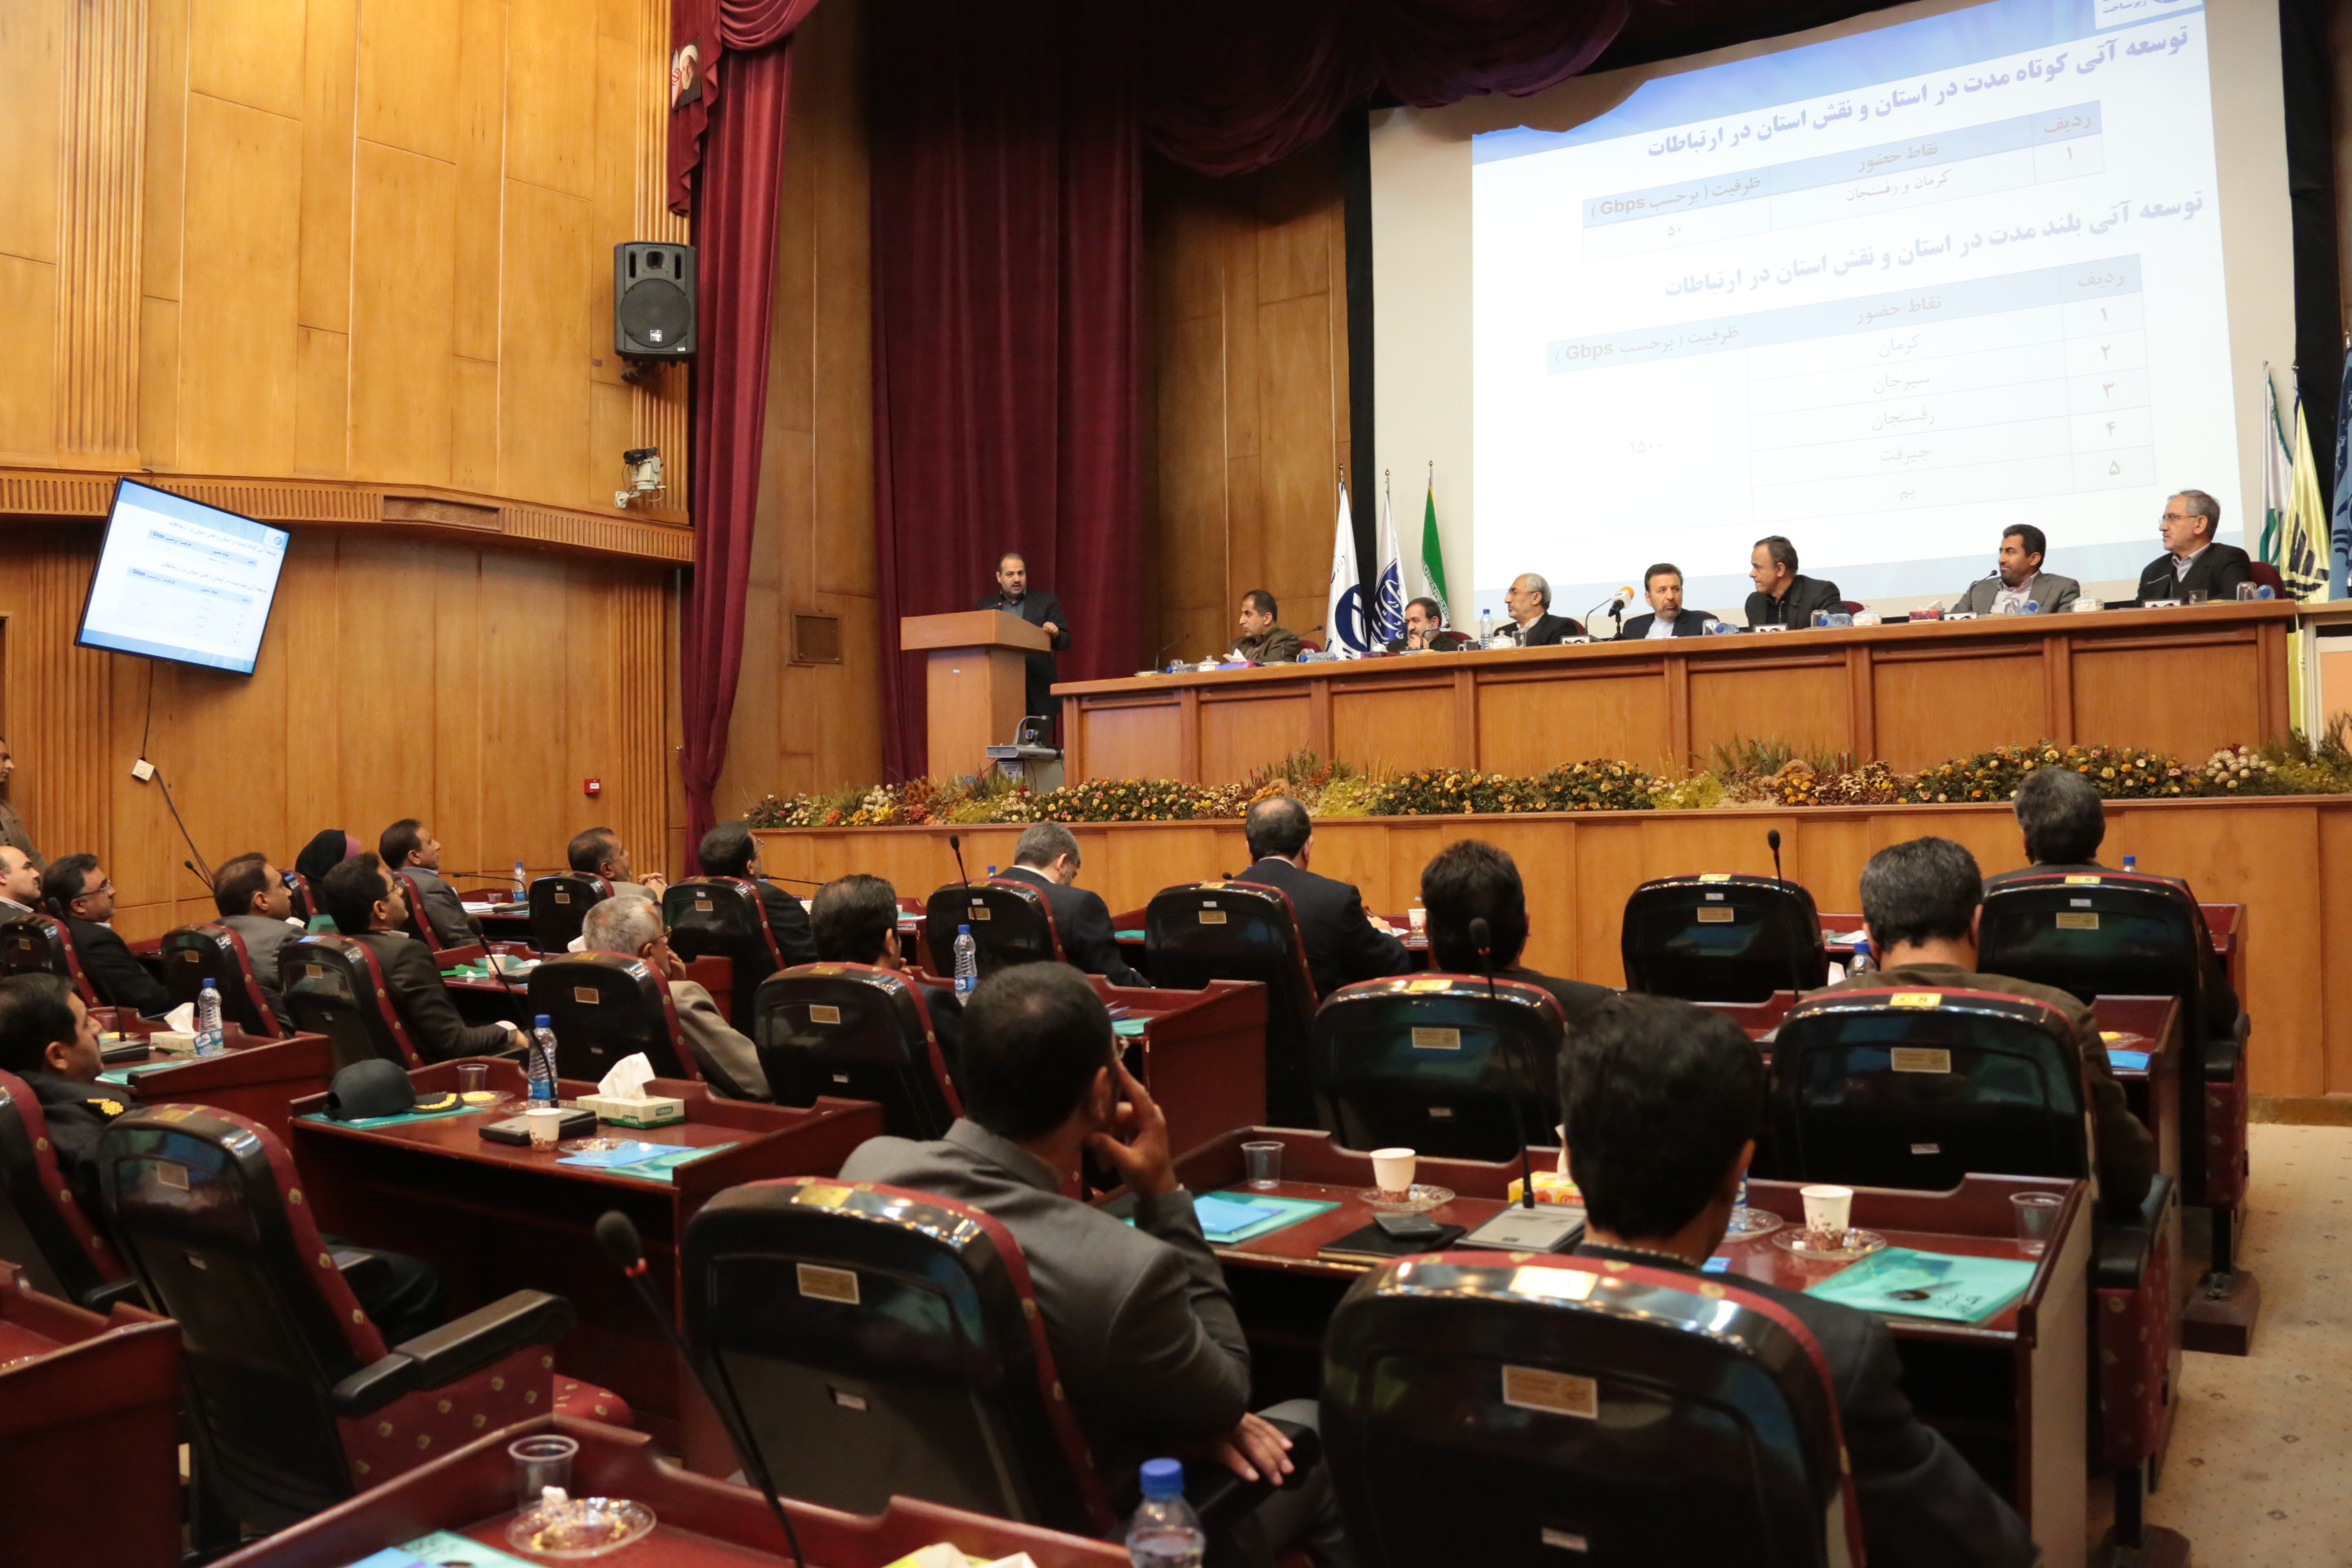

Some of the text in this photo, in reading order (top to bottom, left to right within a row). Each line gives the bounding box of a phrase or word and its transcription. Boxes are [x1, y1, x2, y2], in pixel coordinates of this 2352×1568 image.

[1648, 25, 2189, 156] توسعه آتی کوتاه مدت در استان و نقش استان در ارتباطات
[2043, 114, 2091, 136] ردیف
[1858, 141, 1939, 173] نقاط حضور
[1712, 176, 1761, 197] ظرفیت
[1914, 168, 1953, 190] کرمان
[1846, 185, 1898, 203] رفسنجان
[1601, 198, 1645, 216] Gbps
[1665, 191, 2203, 296] توسعه آتی بلند مدت در استان و نقش استان در ارتباطات
[2078, 271, 2123, 289] ردیف
[1855, 295, 1942, 325] نقاط حضور
[1687, 325, 1739, 345] ظرفیت
[1566, 343, 1614, 361] Gbps
[1878, 334, 1921, 358] کرمان
[2100, 344, 2111, 360] ۲
[1873, 374, 1930, 394] سیرجان
[2102, 382, 2115, 399] ۳
[1871, 406, 1935, 431] رفسنجان
[2105, 421, 2117, 437] ۴
[1879, 446, 1930, 466] جیرفت
[2108, 460, 2121, 476] ۵
